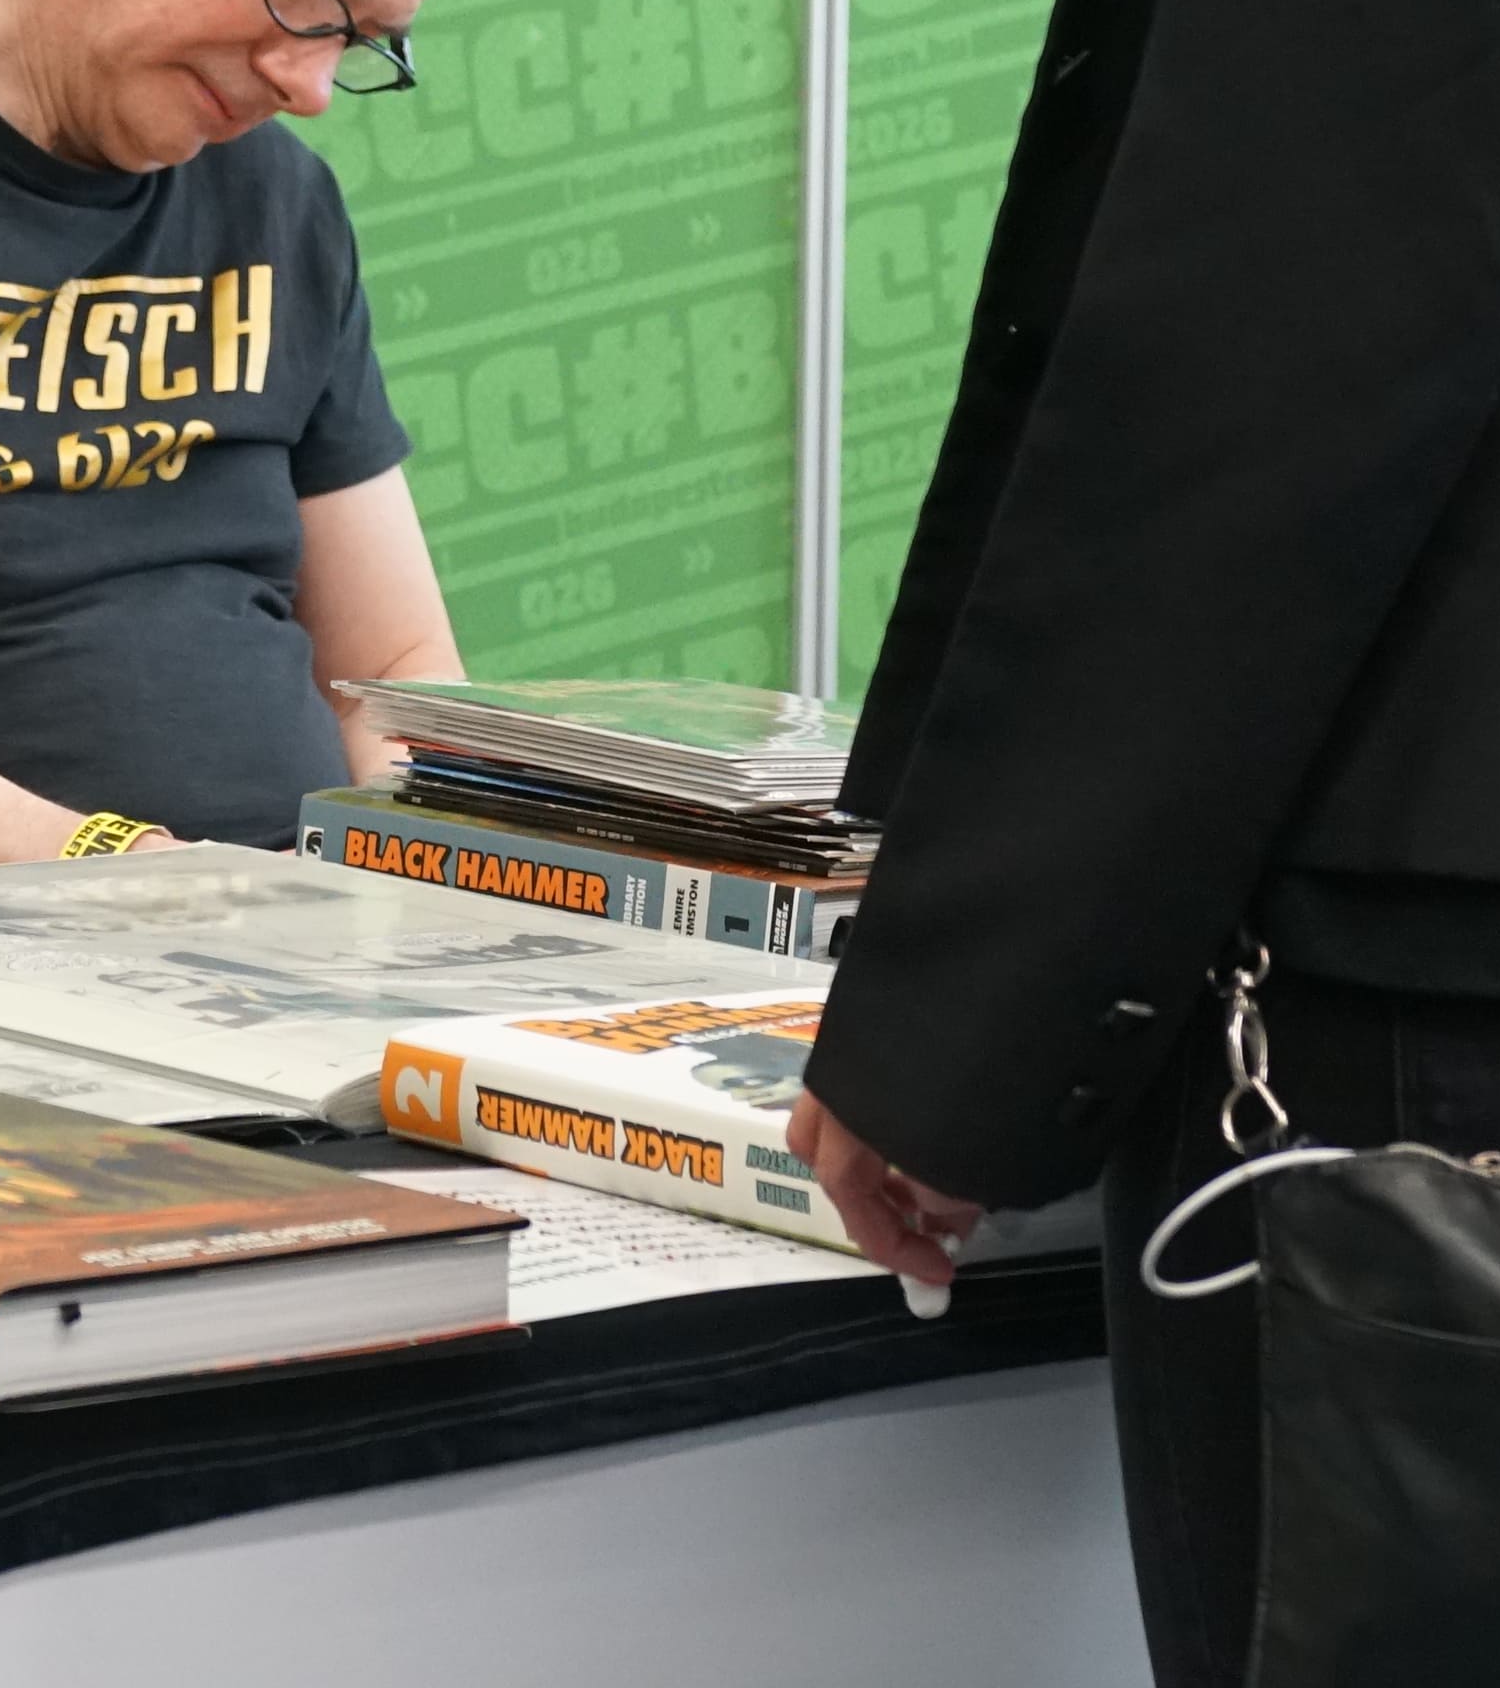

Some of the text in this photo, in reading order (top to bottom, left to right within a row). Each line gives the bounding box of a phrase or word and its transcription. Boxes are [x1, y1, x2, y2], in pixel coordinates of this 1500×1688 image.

[344, 826, 612, 920] BLACK HAMMER
[672, 887, 686, 935] EMIRE
[394, 1064, 443, 1123] 2
[475, 1085, 725, 1189] BLACK HAMMER
